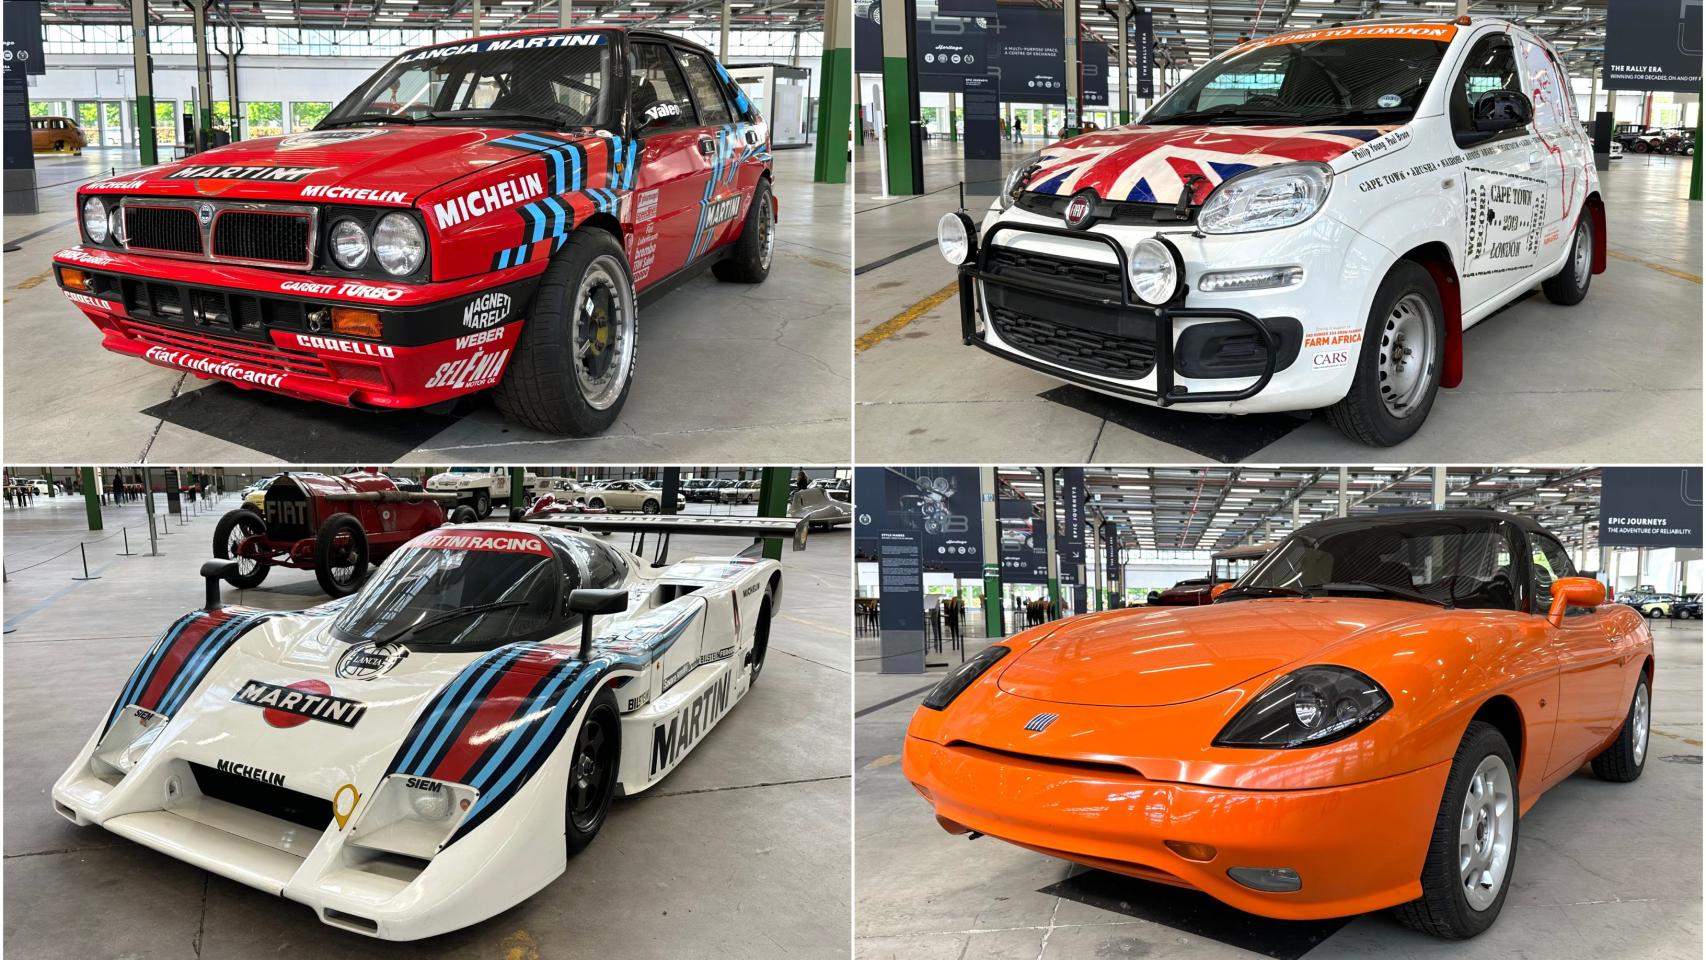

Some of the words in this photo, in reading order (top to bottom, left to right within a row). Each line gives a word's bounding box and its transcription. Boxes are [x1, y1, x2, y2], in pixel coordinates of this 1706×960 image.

[1355, 26, 1448, 37] LONDON
[401, 43, 479, 64] LANCIA
[486, 34, 600, 52] MARTINI
[1610, 64, 1625, 72] THE
[645, 103, 680, 120] Valeo
[1351, 147, 1371, 161] Philip
[1368, 140, 1388, 157] Young
[1385, 134, 1397, 147] Paul
[171, 166, 315, 181] MARTINI
[1359, 177, 1384, 193] CAPE
[1383, 170, 1406, 185] TOWN
[1410, 161, 1438, 177] ARUSHA
[300, 185, 408, 203] MICHELIN
[434, 172, 543, 231] MICHELIN
[1490, 184, 1512, 204] CAPE
[1512, 188, 1533, 206] TOWN
[705, 195, 741, 229] MARTINI
[1502, 215, 1519, 231] 2013
[1489, 241, 1521, 260] LONDON
[64, 290, 112, 311] CARELLO
[280, 281, 336, 294] GARRETT
[338, 283, 404, 301] TURBO
[463, 306, 511, 329] MARELLI
[296, 335, 395, 358] CARELLO
[456, 326, 505, 351] WEBER
[1304, 334, 1330, 348] FARM
[1331, 333, 1362, 345] AFRICA
[145, 345, 179, 363] Fiat
[178, 353, 288, 389] Lubrificanti
[1313, 351, 1348, 366] CARS
[465, 378, 486, 388] MOTOR
[266, 500, 306, 525] FIAT
[1608, 517, 1626, 525] EPIC
[1627, 518, 1667, 526] JOURNEYS
[467, 537, 542, 551] RACING
[353, 656, 382, 666] LANCIA
[238, 683, 368, 725] MARTINI
[134, 709, 155, 721] SIEM
[650, 668, 733, 776] MARTINI
[216, 758, 287, 787] MICHELIN
[405, 776, 444, 794] SIEM
